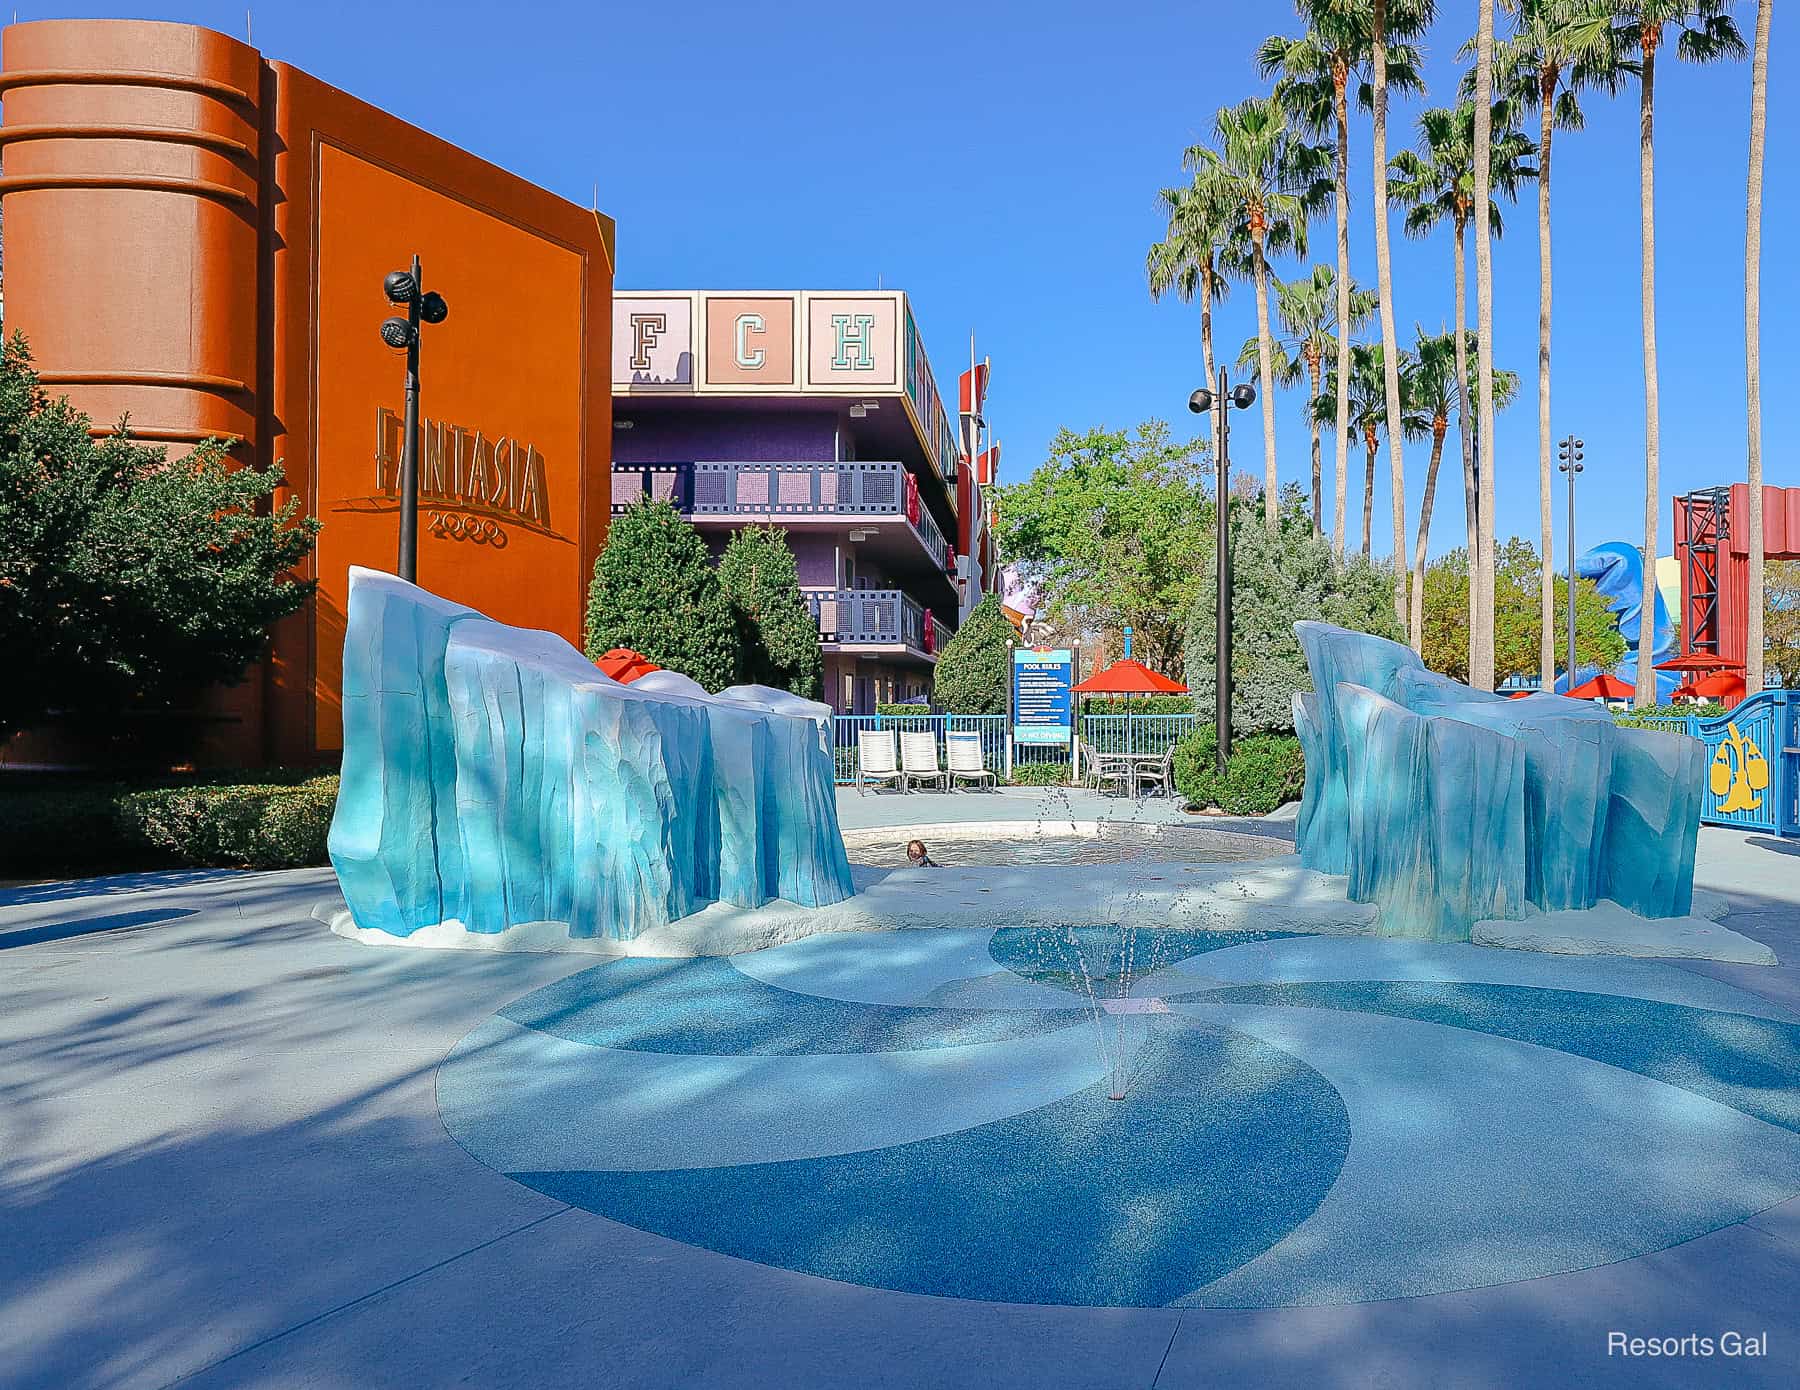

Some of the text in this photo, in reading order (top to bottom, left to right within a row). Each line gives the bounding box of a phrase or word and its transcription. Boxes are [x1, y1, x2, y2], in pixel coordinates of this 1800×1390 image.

[630, 313, 666, 370] F
[734, 313, 766, 370] C
[831, 314, 875, 370] H
[428, 511, 499, 538] 2000
